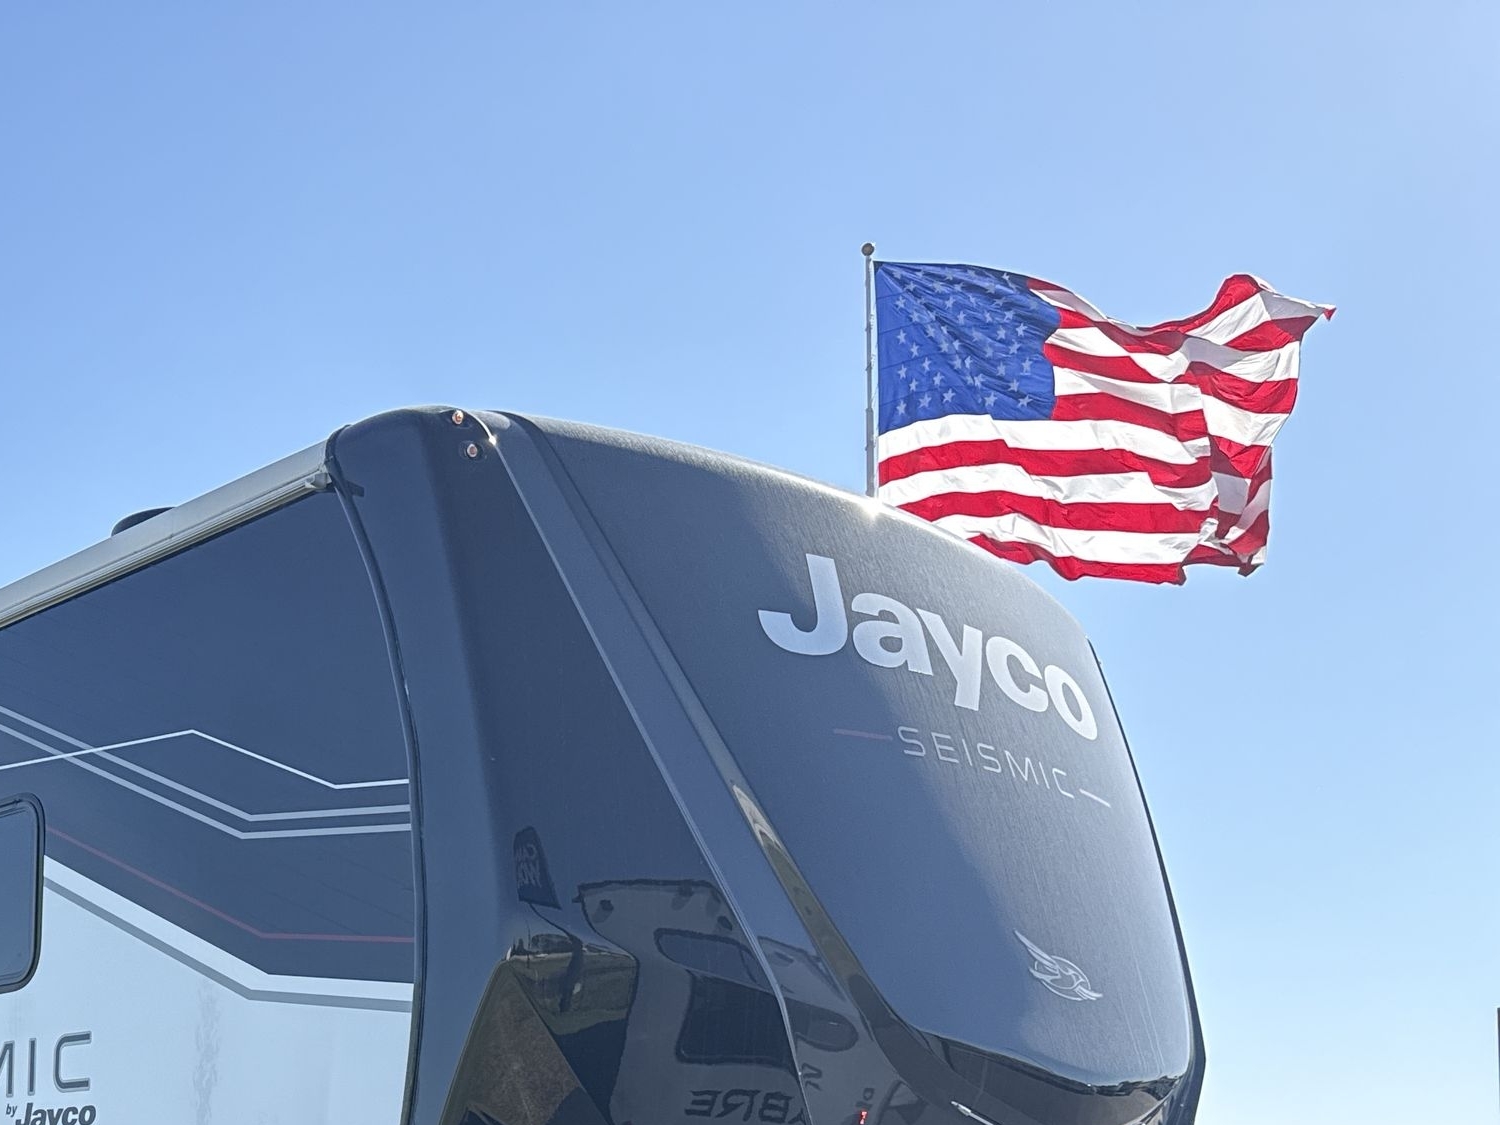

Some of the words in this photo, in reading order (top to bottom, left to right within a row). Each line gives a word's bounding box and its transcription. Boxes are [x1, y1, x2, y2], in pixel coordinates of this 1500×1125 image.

[758, 553, 1098, 740] Jayco
[897, 725, 1076, 799] SEISMIC
[6, 1103, 18, 1118] by
